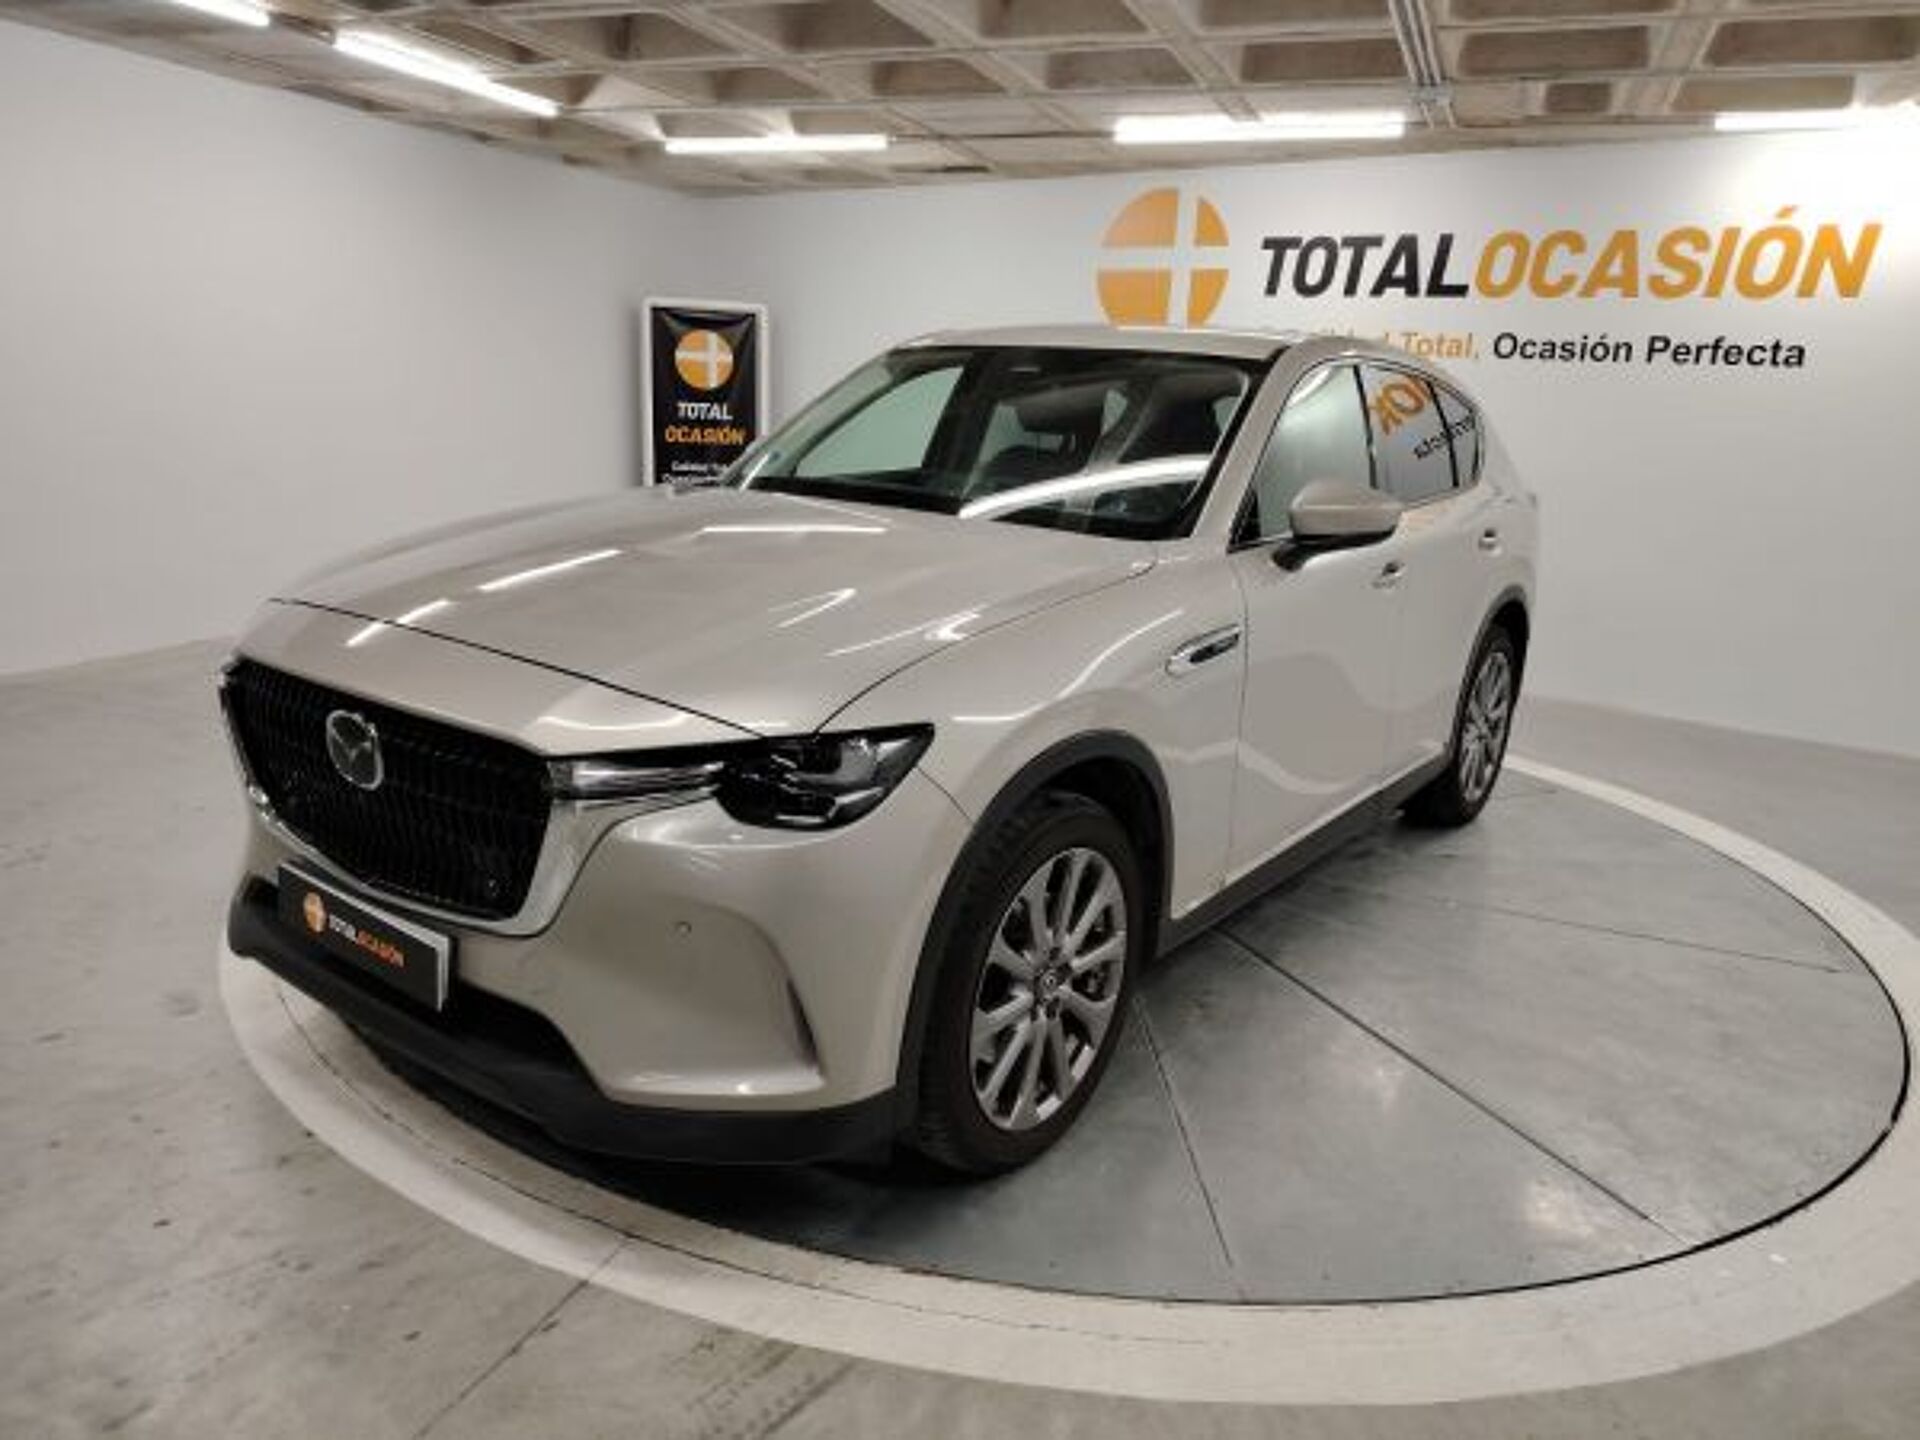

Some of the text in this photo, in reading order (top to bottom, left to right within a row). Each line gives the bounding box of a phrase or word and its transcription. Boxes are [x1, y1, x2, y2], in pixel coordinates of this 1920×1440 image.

[1493, 333, 1633, 363] Ocasión
[1646, 334, 1806, 368] Perfecta
[676, 402, 733, 420] TOTAL
